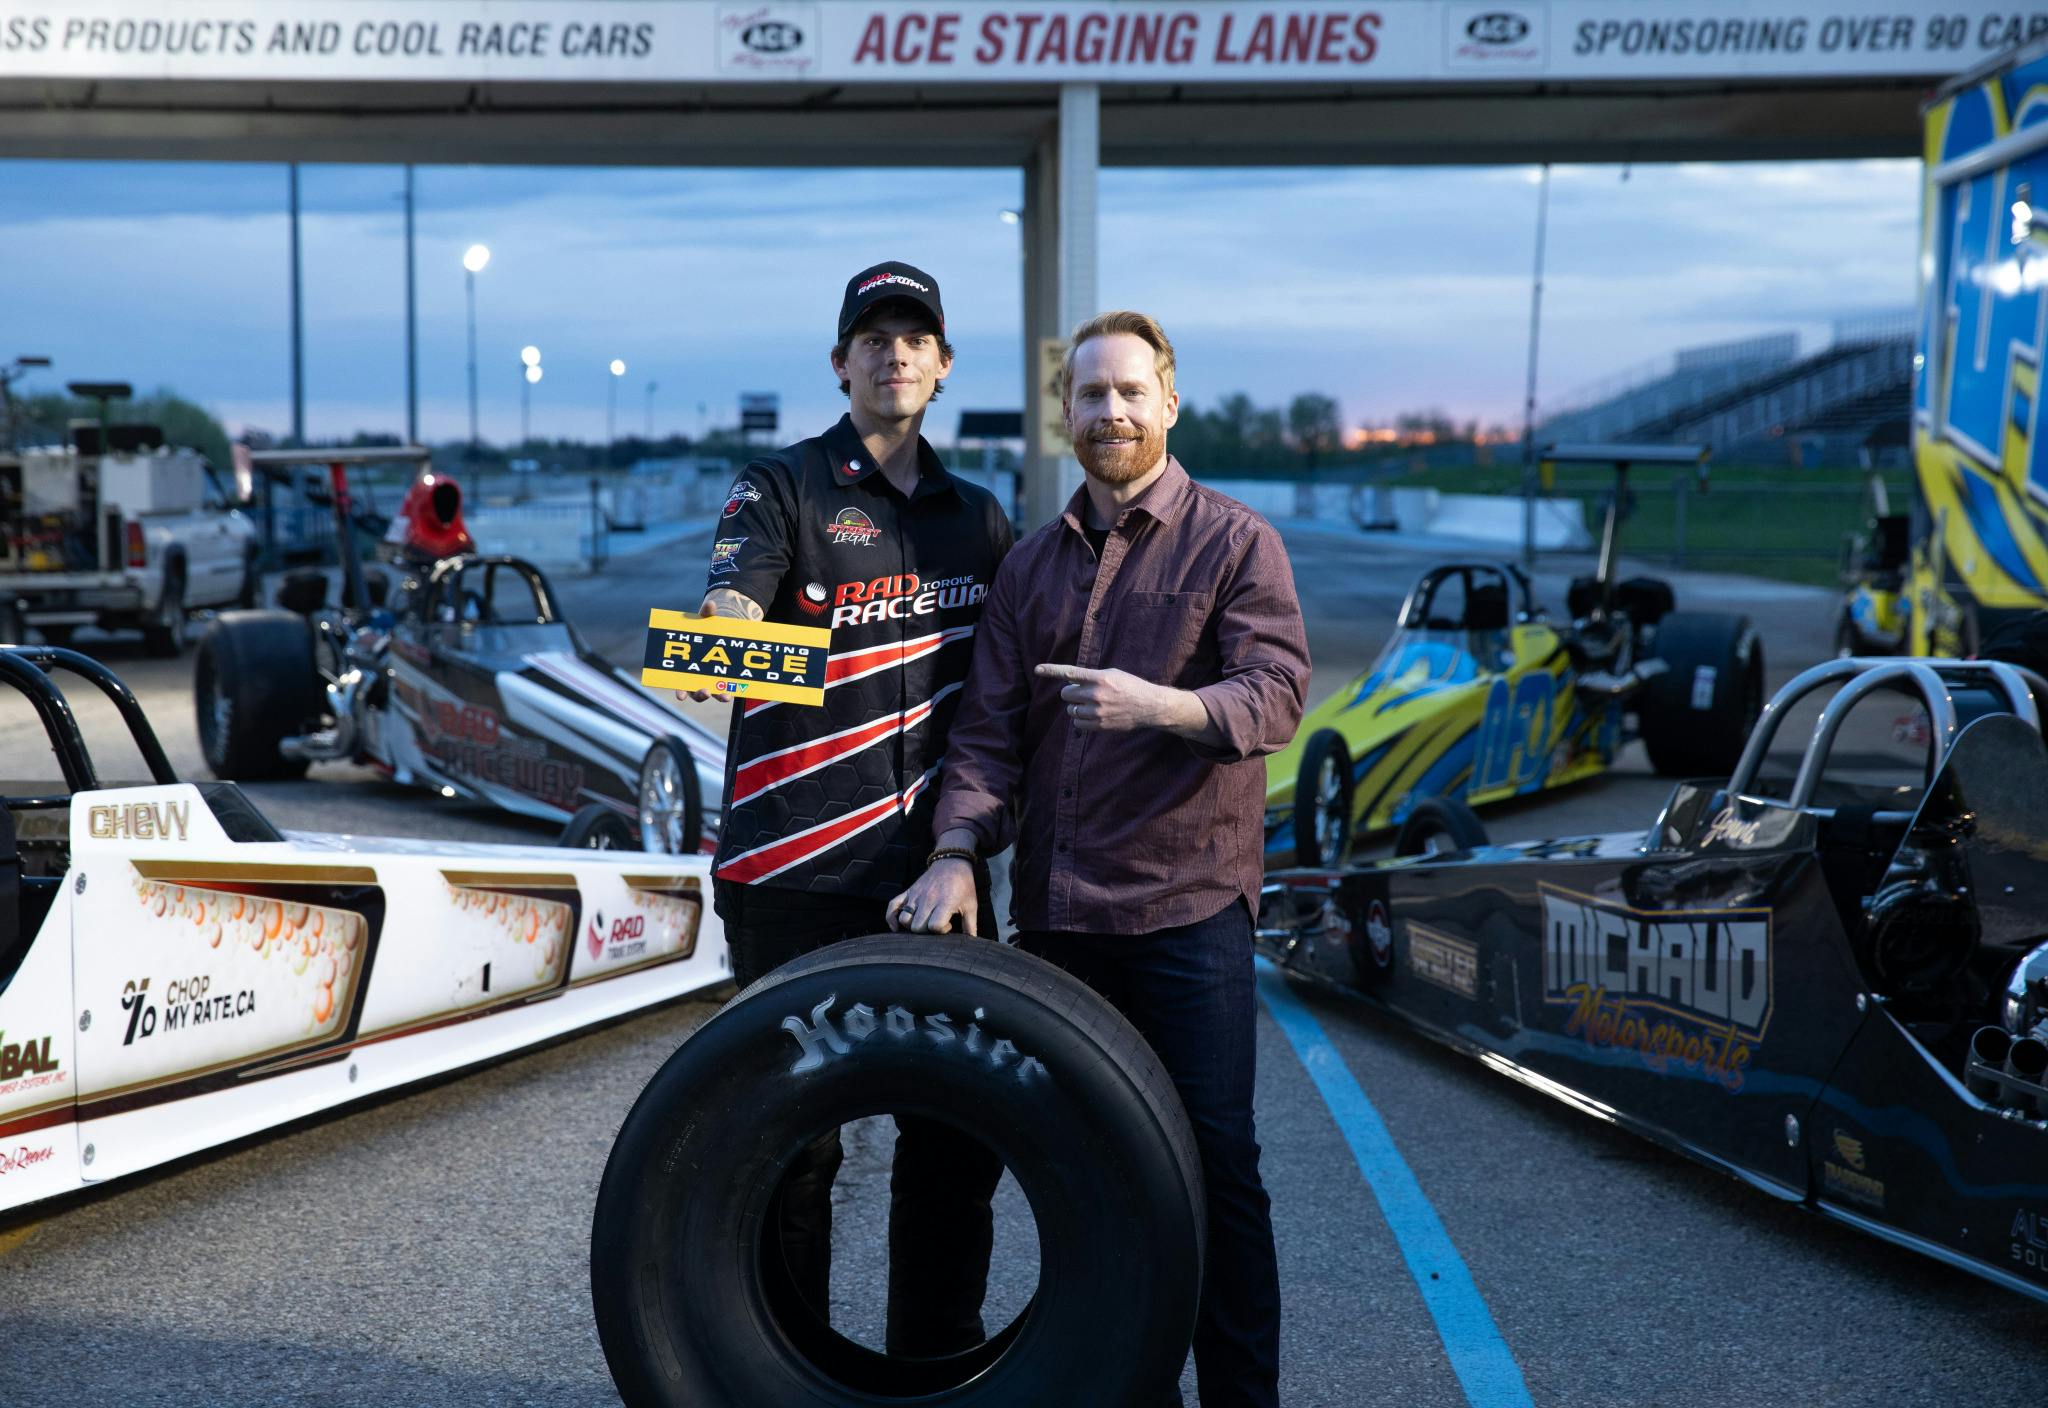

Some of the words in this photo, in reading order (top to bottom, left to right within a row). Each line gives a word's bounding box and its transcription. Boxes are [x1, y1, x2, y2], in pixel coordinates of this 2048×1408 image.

[0, 17, 49, 51] SS
[62, 18, 256, 56] PRODUCTS
[266, 20, 343, 56] AND
[352, 22, 443, 56] COOL
[457, 22, 549, 57] RACE
[560, 23, 655, 57] CARS
[854, 13, 961, 64] ACE
[973, 12, 1199, 64] STAGING
[1213, 12, 1382, 63] LANES
[1573, 19, 1808, 56] SPONSORING
[1817, 16, 1914, 53] OVER
[1925, 15, 1967, 51] 90
[857, 274, 929, 295] RACEWAY
[832, 530, 877, 547] LEGAL
[834, 573, 920, 607] RAD
[921, 575, 974, 592] TORQUE
[662, 640, 808, 674] RACE
[666, 632, 704, 643] THE
[715, 638, 810, 656] AMAZING
[661, 659, 806, 684] CANADA
[715, 681, 749, 693] CTV
[611, 914, 645, 943] RAD
[1543, 894, 1768, 1029] MICHAUD
[167, 975, 210, 1006] CHOP
[164, 1003, 190, 1032] MY
[781, 993, 1048, 1077] Hoosier
[1566, 984, 1752, 1094] Motorsports
[0, 1036, 59, 1081] BAL
